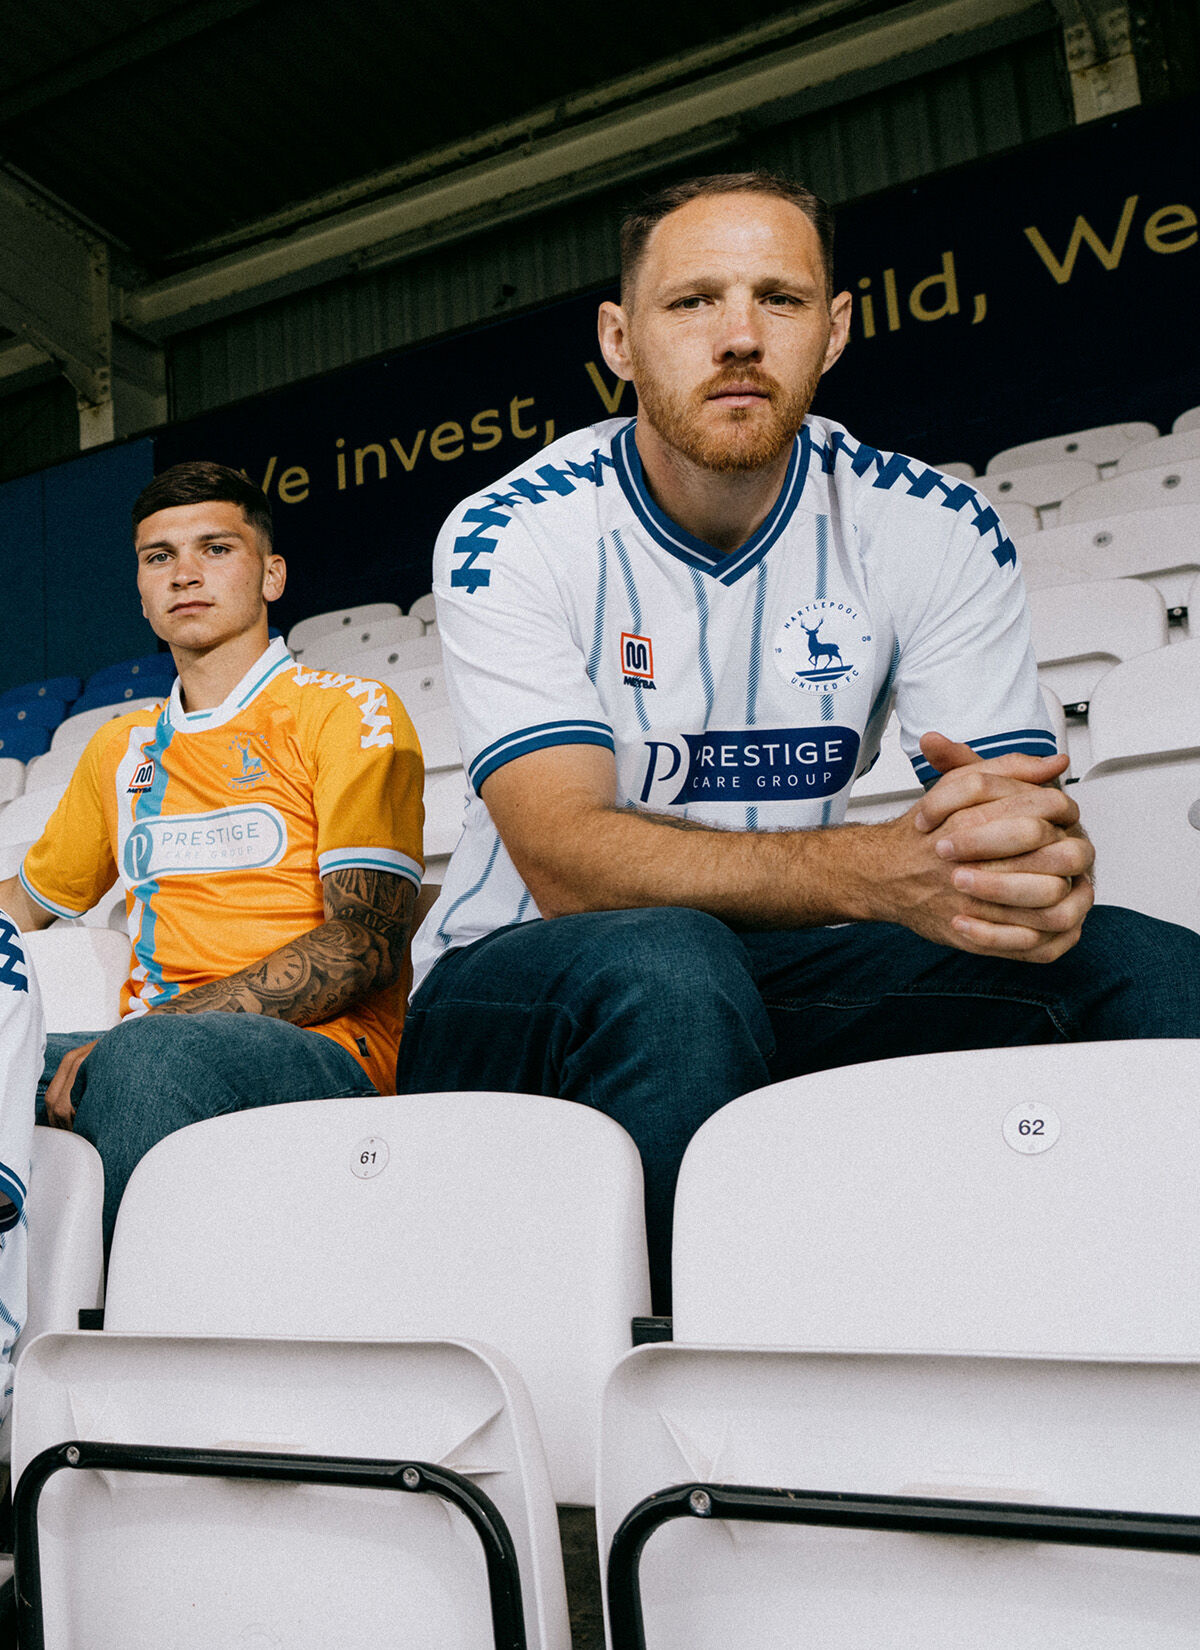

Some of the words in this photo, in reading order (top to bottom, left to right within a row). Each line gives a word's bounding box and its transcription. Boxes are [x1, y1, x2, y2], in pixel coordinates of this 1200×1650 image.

[336, 395, 555, 490] invest,
[849, 251, 988, 343] ild,
[1023, 195, 1200, 285] We
[784, 602, 858, 629] HARTLEPOOL
[623, 675, 657, 690] MEYBA
[791, 677, 838, 691] UNITED
[845, 669, 859, 683] FC
[696, 739, 843, 767] RESTIGE
[692, 776, 741, 788] CARE
[756, 772, 832, 787] GROUP
[161, 822, 260, 847] PRESTIGE
[210, 845, 254, 860] GROUP
[1018, 1119, 1045, 1136] 62
[360, 1151, 377, 1164] 61
